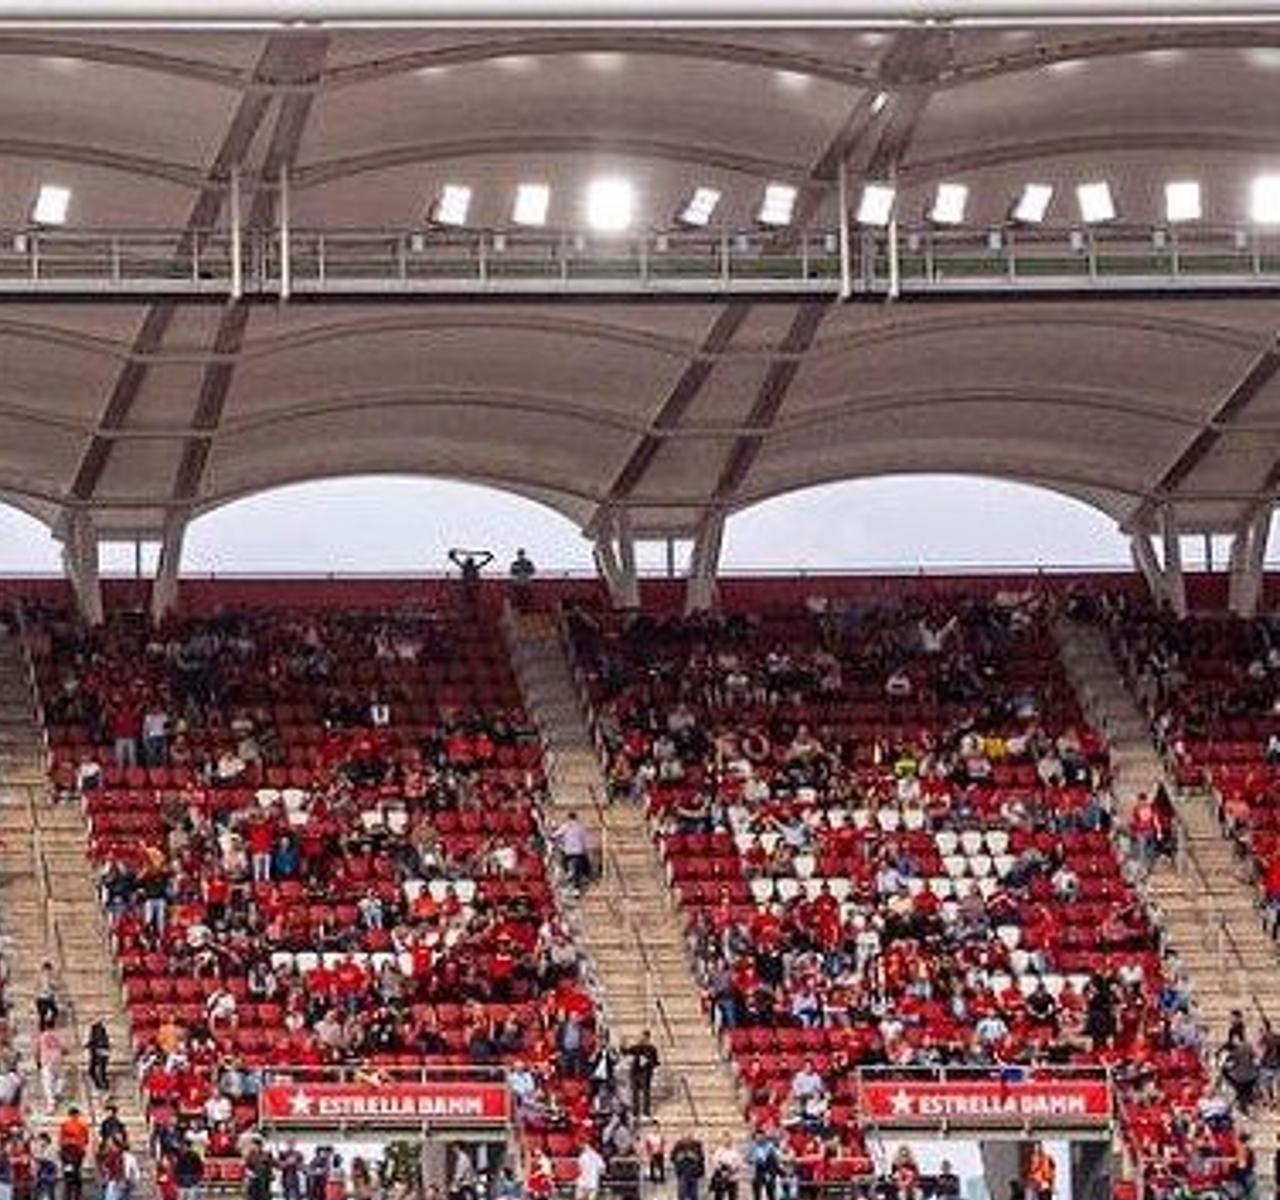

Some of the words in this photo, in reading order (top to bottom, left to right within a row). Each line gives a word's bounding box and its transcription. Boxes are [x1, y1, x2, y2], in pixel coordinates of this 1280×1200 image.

[319, 1097, 416, 1114] ESTRELLA
[419, 1097, 483, 1114] DAMM
[920, 1096, 1018, 1114] ESTRELLA
[1020, 1097, 1087, 1115] DAMM
